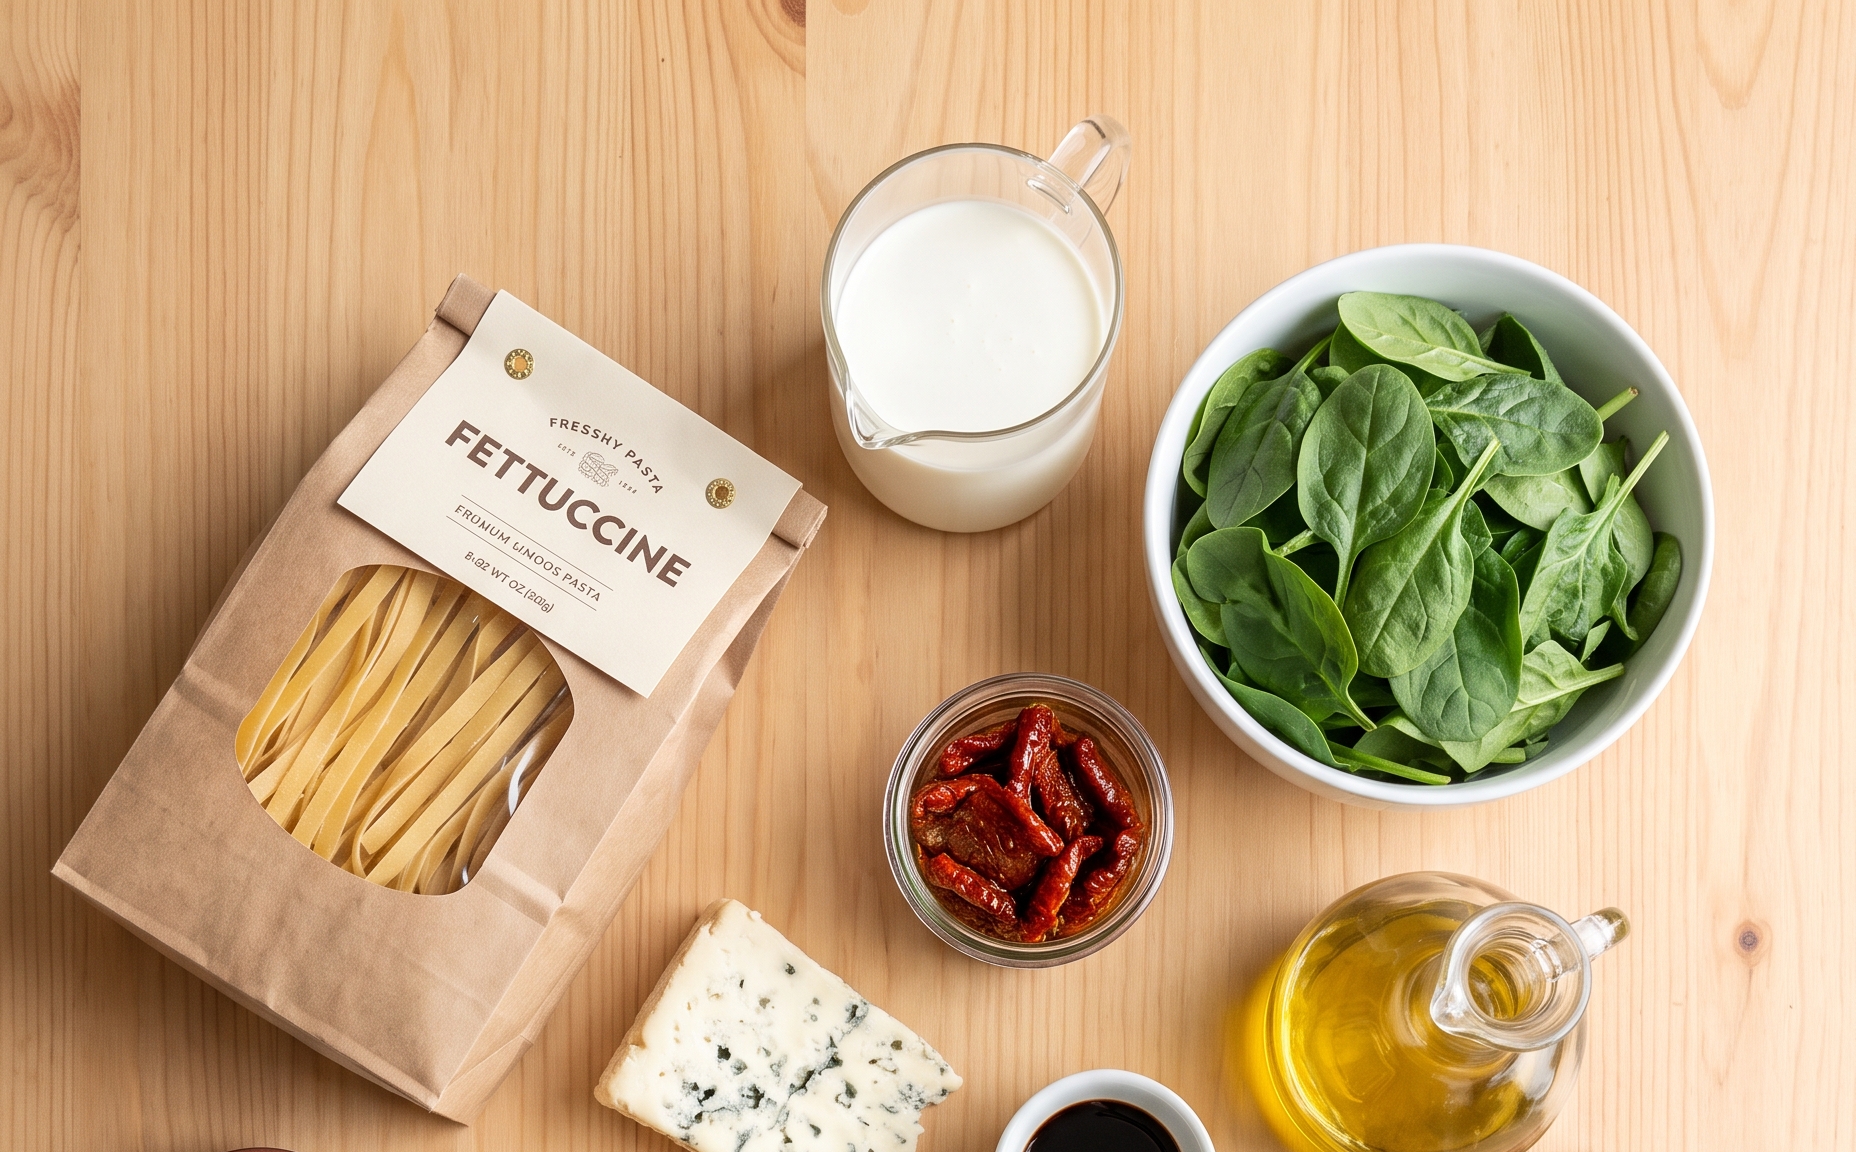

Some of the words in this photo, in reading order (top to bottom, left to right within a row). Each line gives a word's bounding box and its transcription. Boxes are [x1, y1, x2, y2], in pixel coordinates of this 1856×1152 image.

[549, 417, 623, 450] FRESSHY
[624, 449, 664, 493] PASTA
[444, 419, 692, 588] FETTUCCINE
[490, 566, 510, 583] WT
[508, 579, 526, 596] OZ
[561, 572, 601, 601] PASTA
